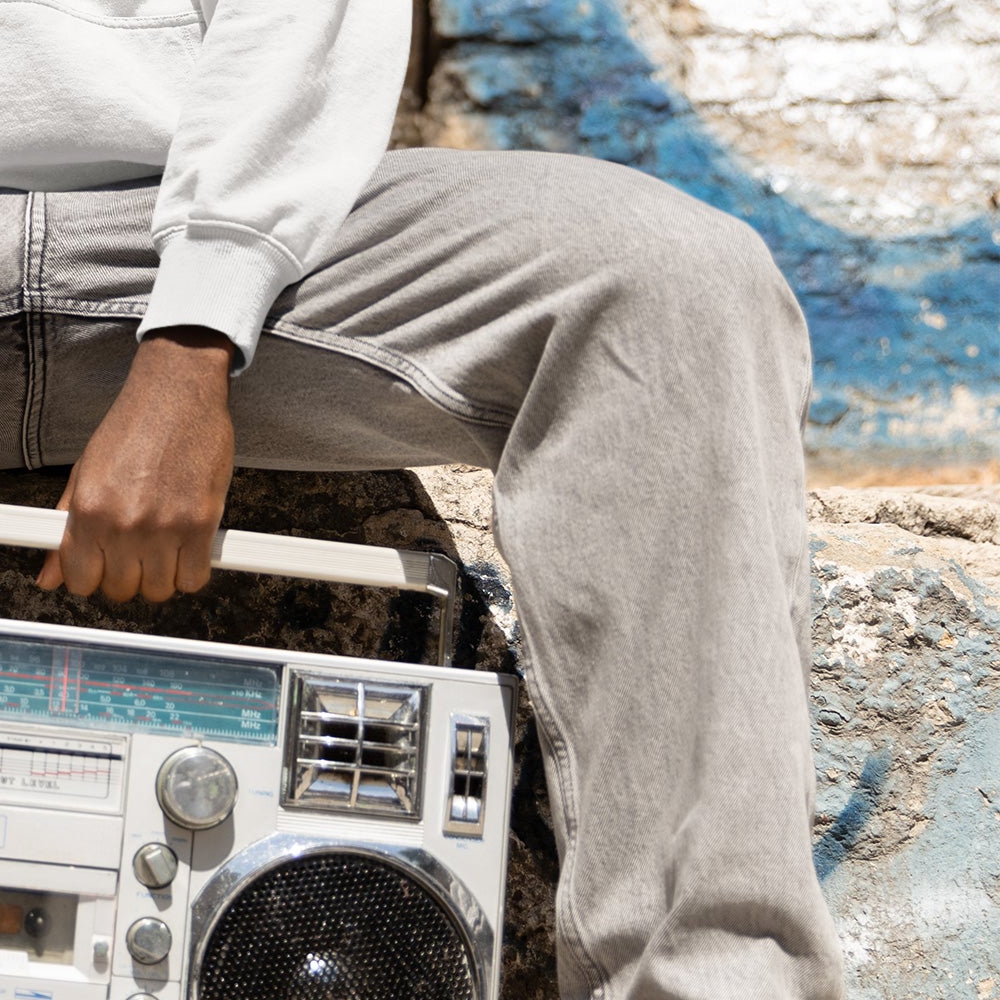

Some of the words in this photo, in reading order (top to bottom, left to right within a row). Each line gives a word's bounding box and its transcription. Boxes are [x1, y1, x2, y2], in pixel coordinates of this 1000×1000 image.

[241, 708, 261, 718] MHz
[241, 720, 261, 729] MHz
[21, 777, 60, 789] LEVEL
